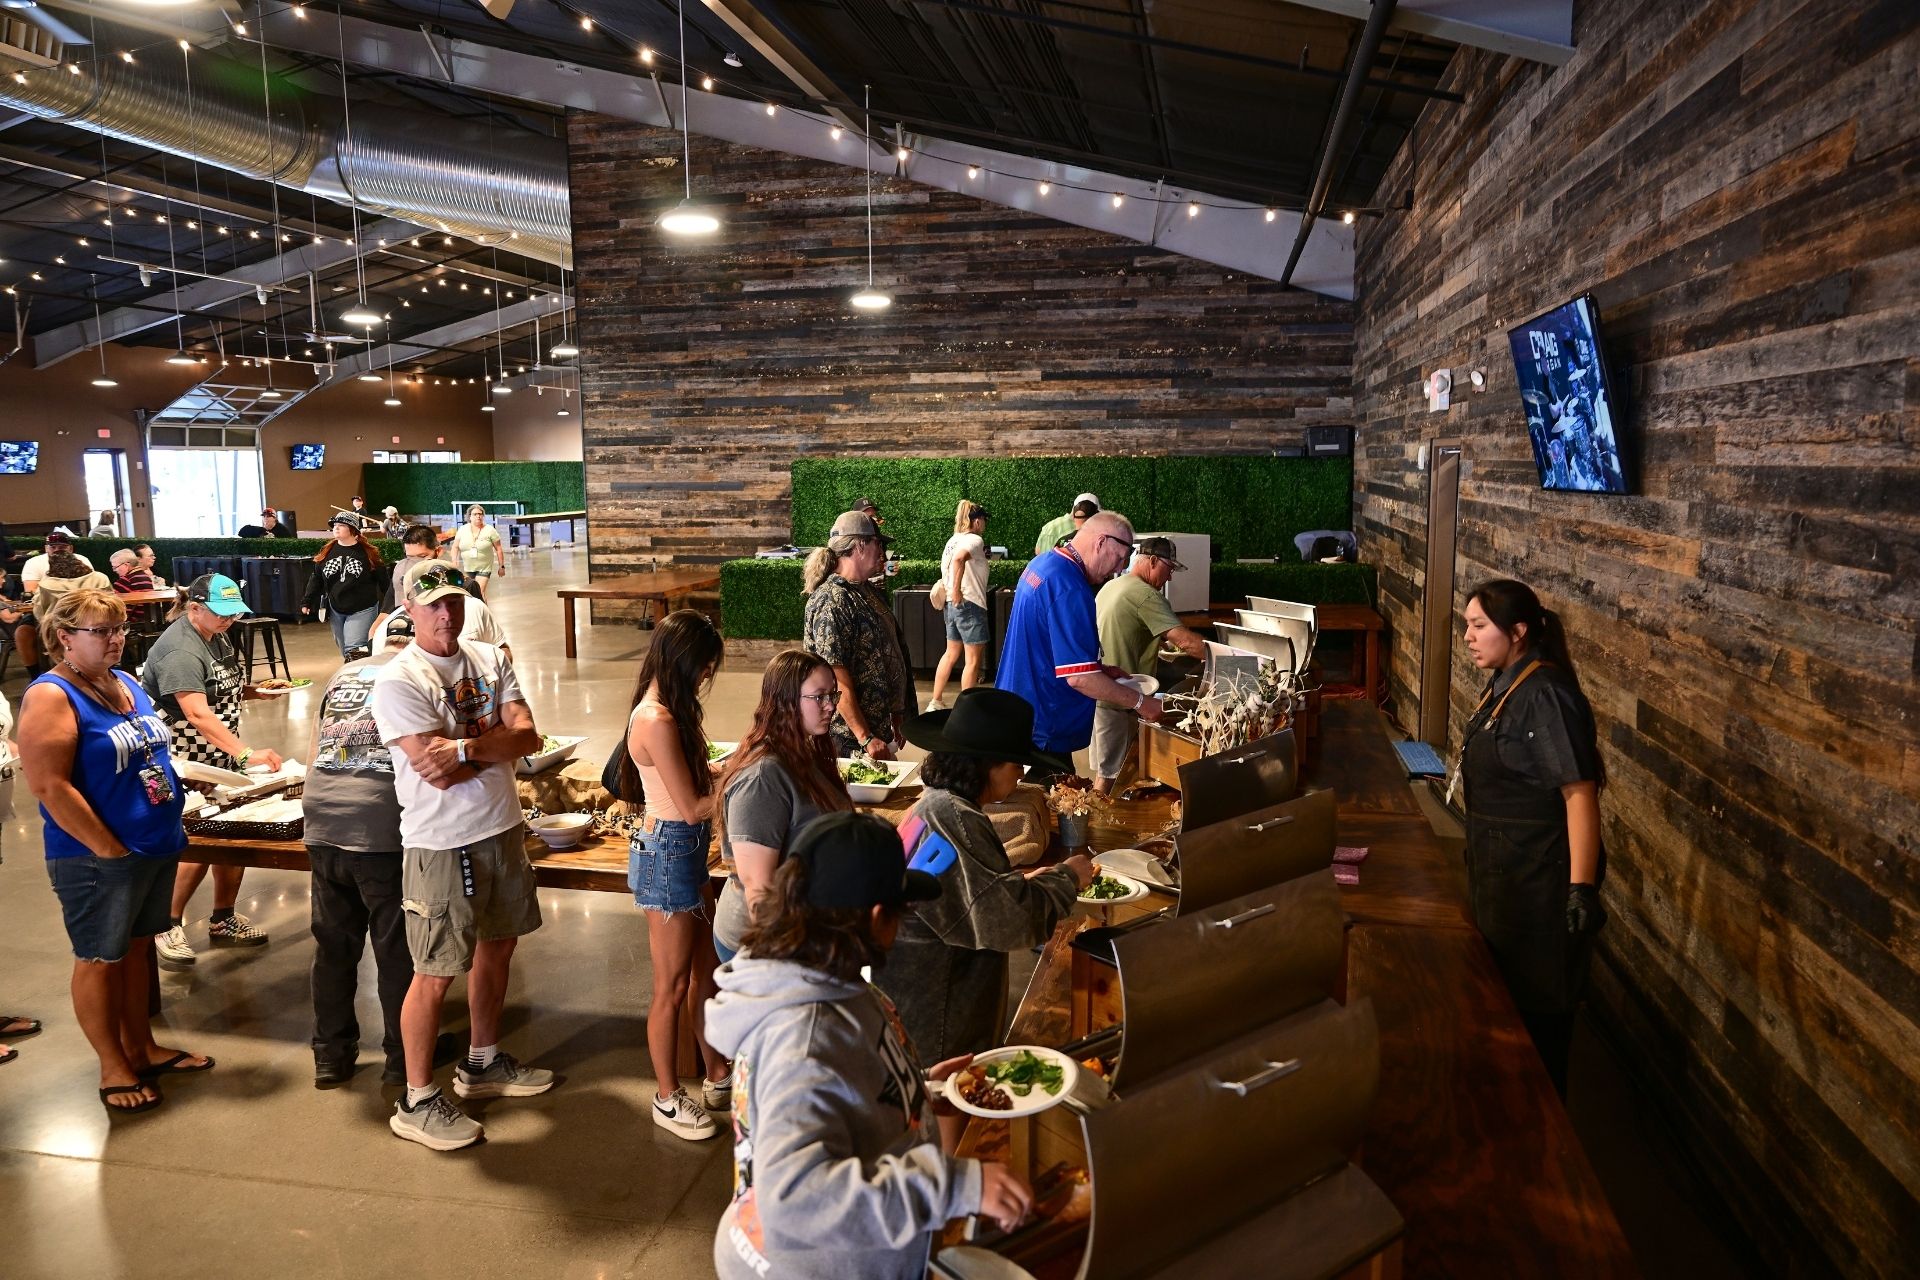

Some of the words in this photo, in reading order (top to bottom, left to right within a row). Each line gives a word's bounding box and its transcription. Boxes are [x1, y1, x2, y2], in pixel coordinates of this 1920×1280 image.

[333, 688, 369, 703] 500
[322, 719, 378, 737] TRADITIO
[729, 1225, 771, 1279] JGR
